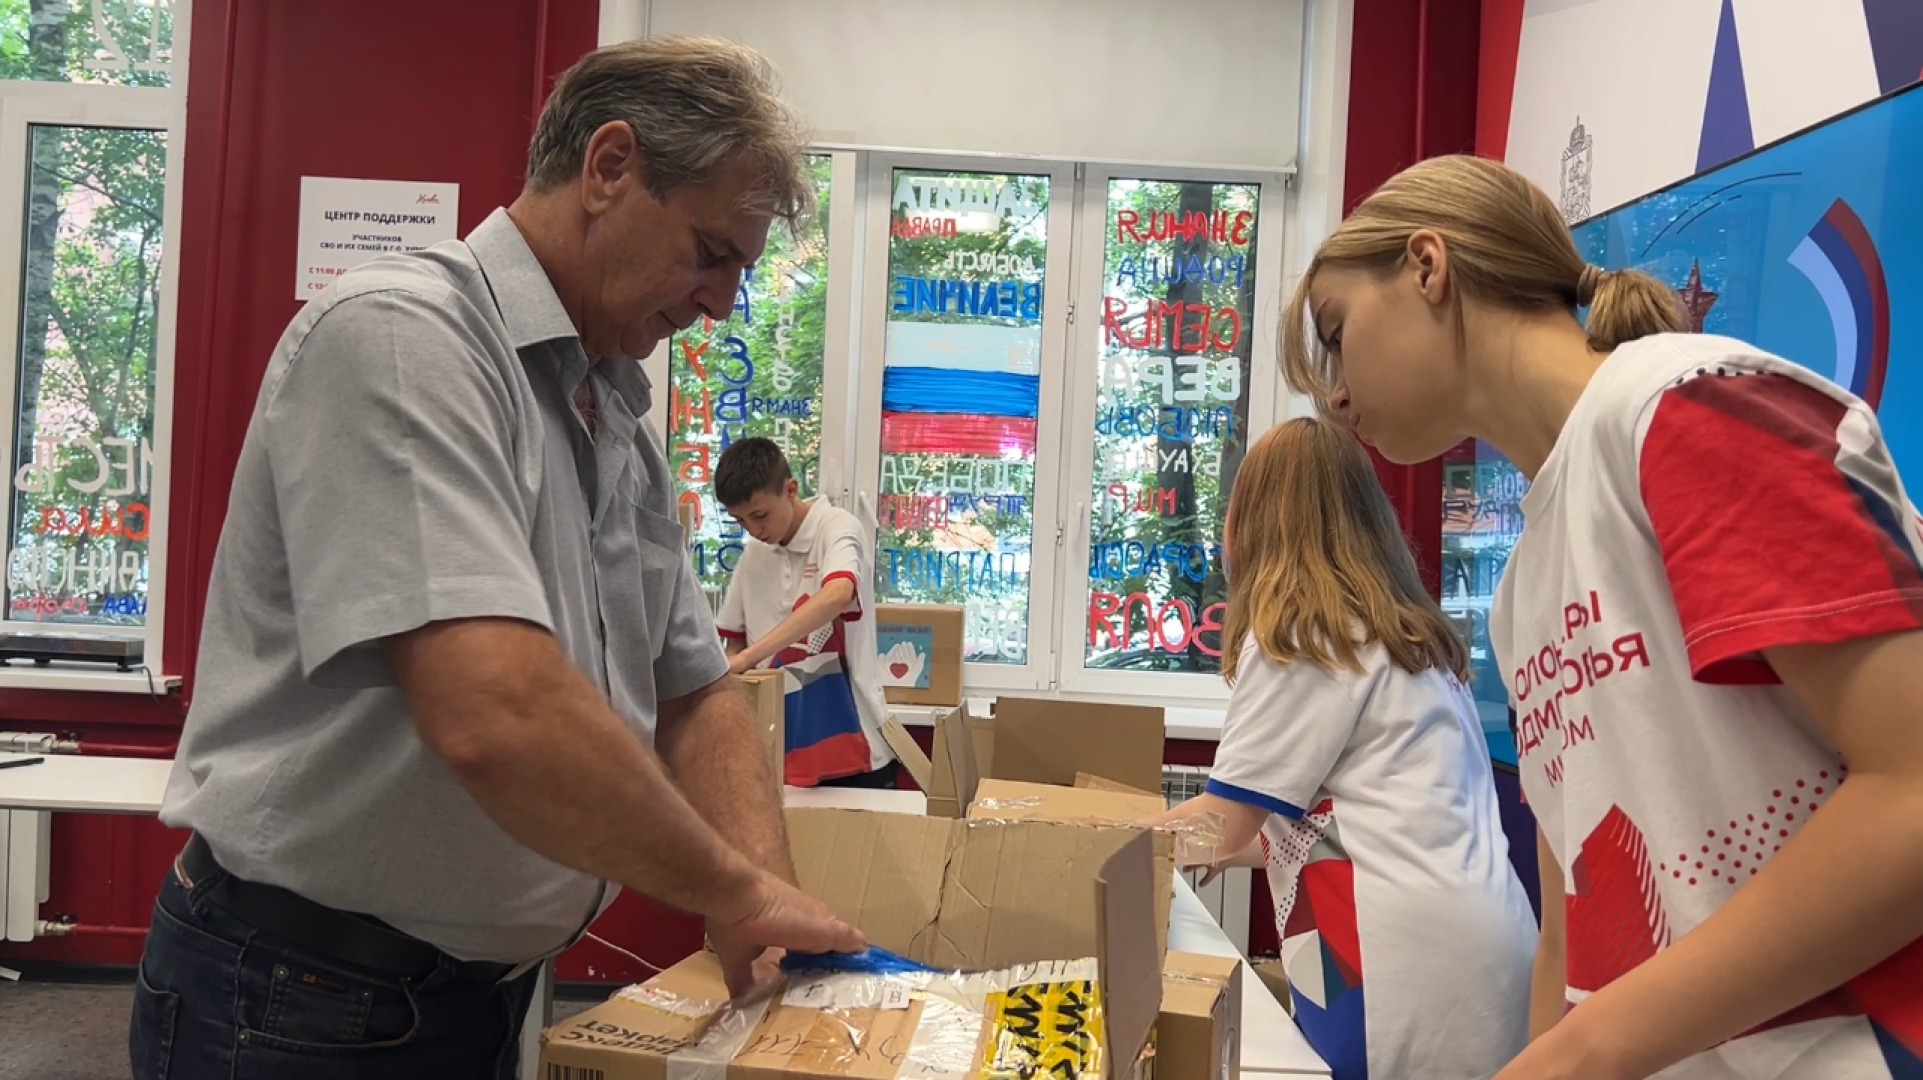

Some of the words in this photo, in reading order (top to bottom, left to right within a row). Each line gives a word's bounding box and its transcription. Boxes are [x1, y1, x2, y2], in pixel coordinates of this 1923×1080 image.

[324, 211, 361, 221] ЦЕНТР
[363, 213, 436, 225] ПОДДЕРЖКИ
[352, 234, 402, 242] УЧАСТНИКОВ
[357, 243, 382, 251] СЕМЕЙ
